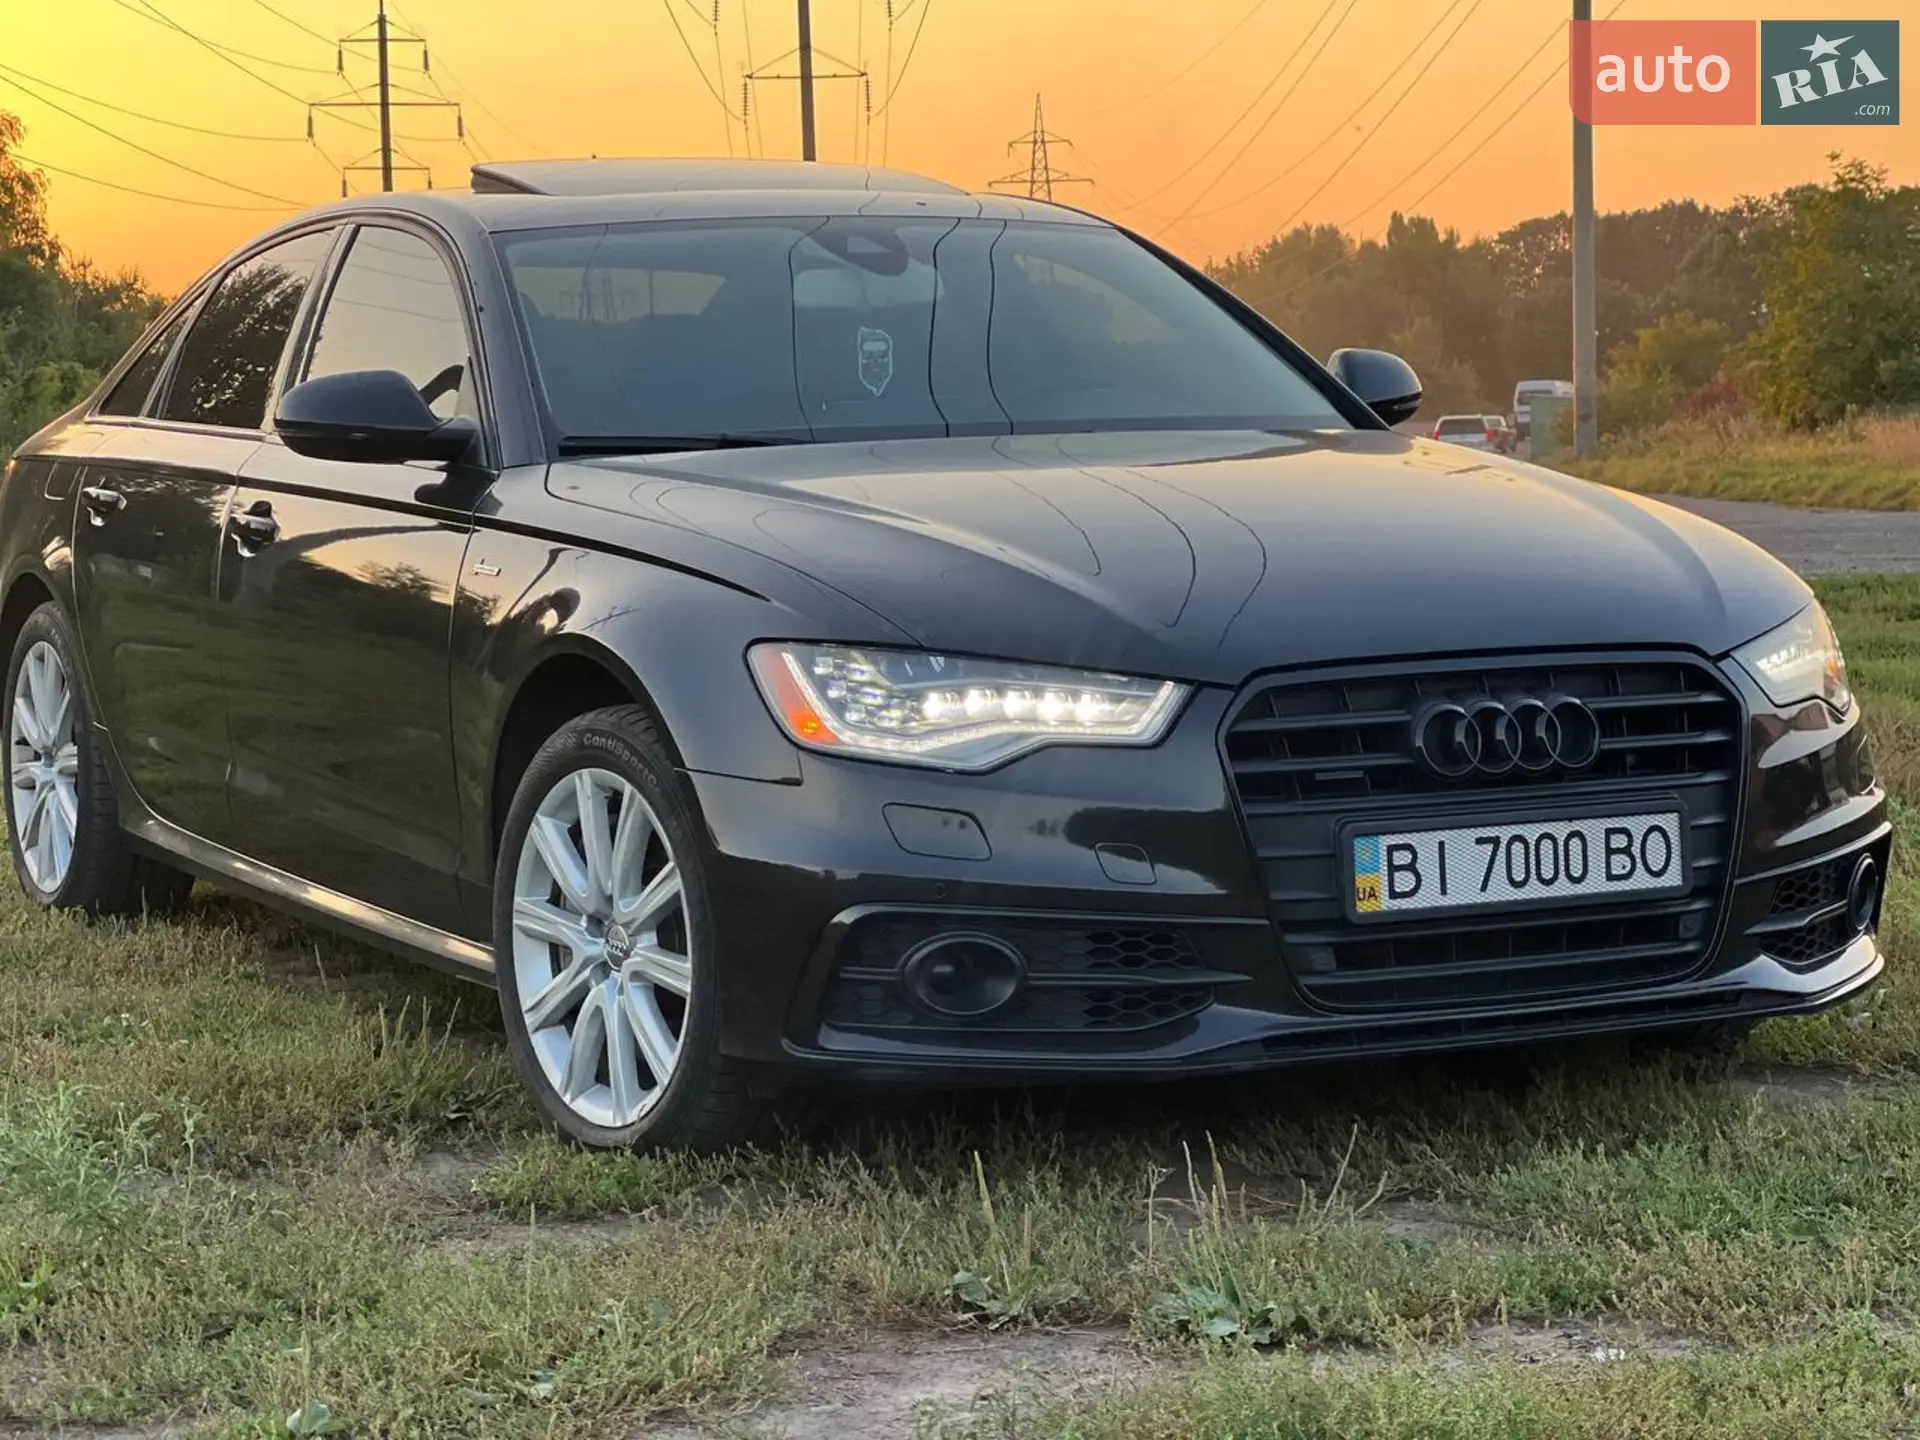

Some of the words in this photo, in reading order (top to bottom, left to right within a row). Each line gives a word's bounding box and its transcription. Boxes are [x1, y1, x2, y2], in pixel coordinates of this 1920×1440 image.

[1386, 840, 1448, 900] BI
[1475, 829, 1589, 893] 7000
[1605, 824, 1672, 882] BO
[1356, 886, 1378, 901] UA
